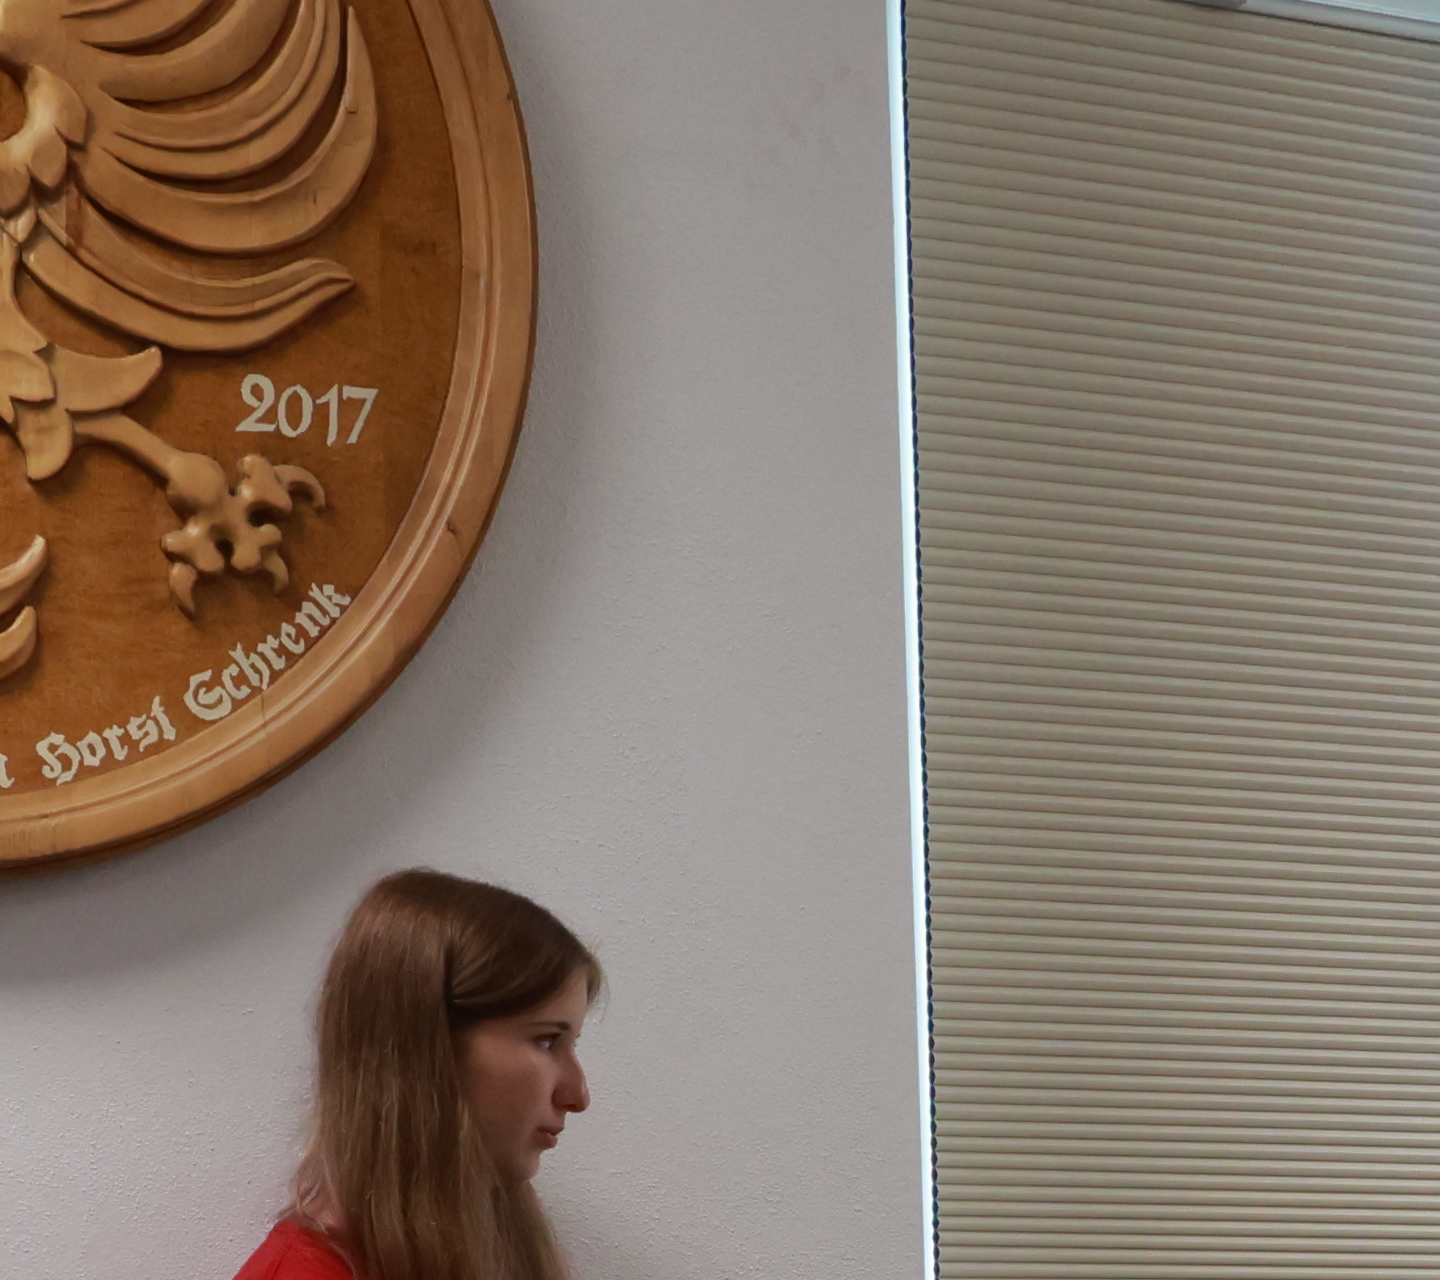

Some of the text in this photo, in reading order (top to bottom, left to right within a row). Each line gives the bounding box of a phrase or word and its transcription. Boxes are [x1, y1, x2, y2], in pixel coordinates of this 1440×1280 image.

[236, 371, 380, 446] 2017
[35, 695, 177, 787] Horst
[182, 581, 352, 721] Schrenk
